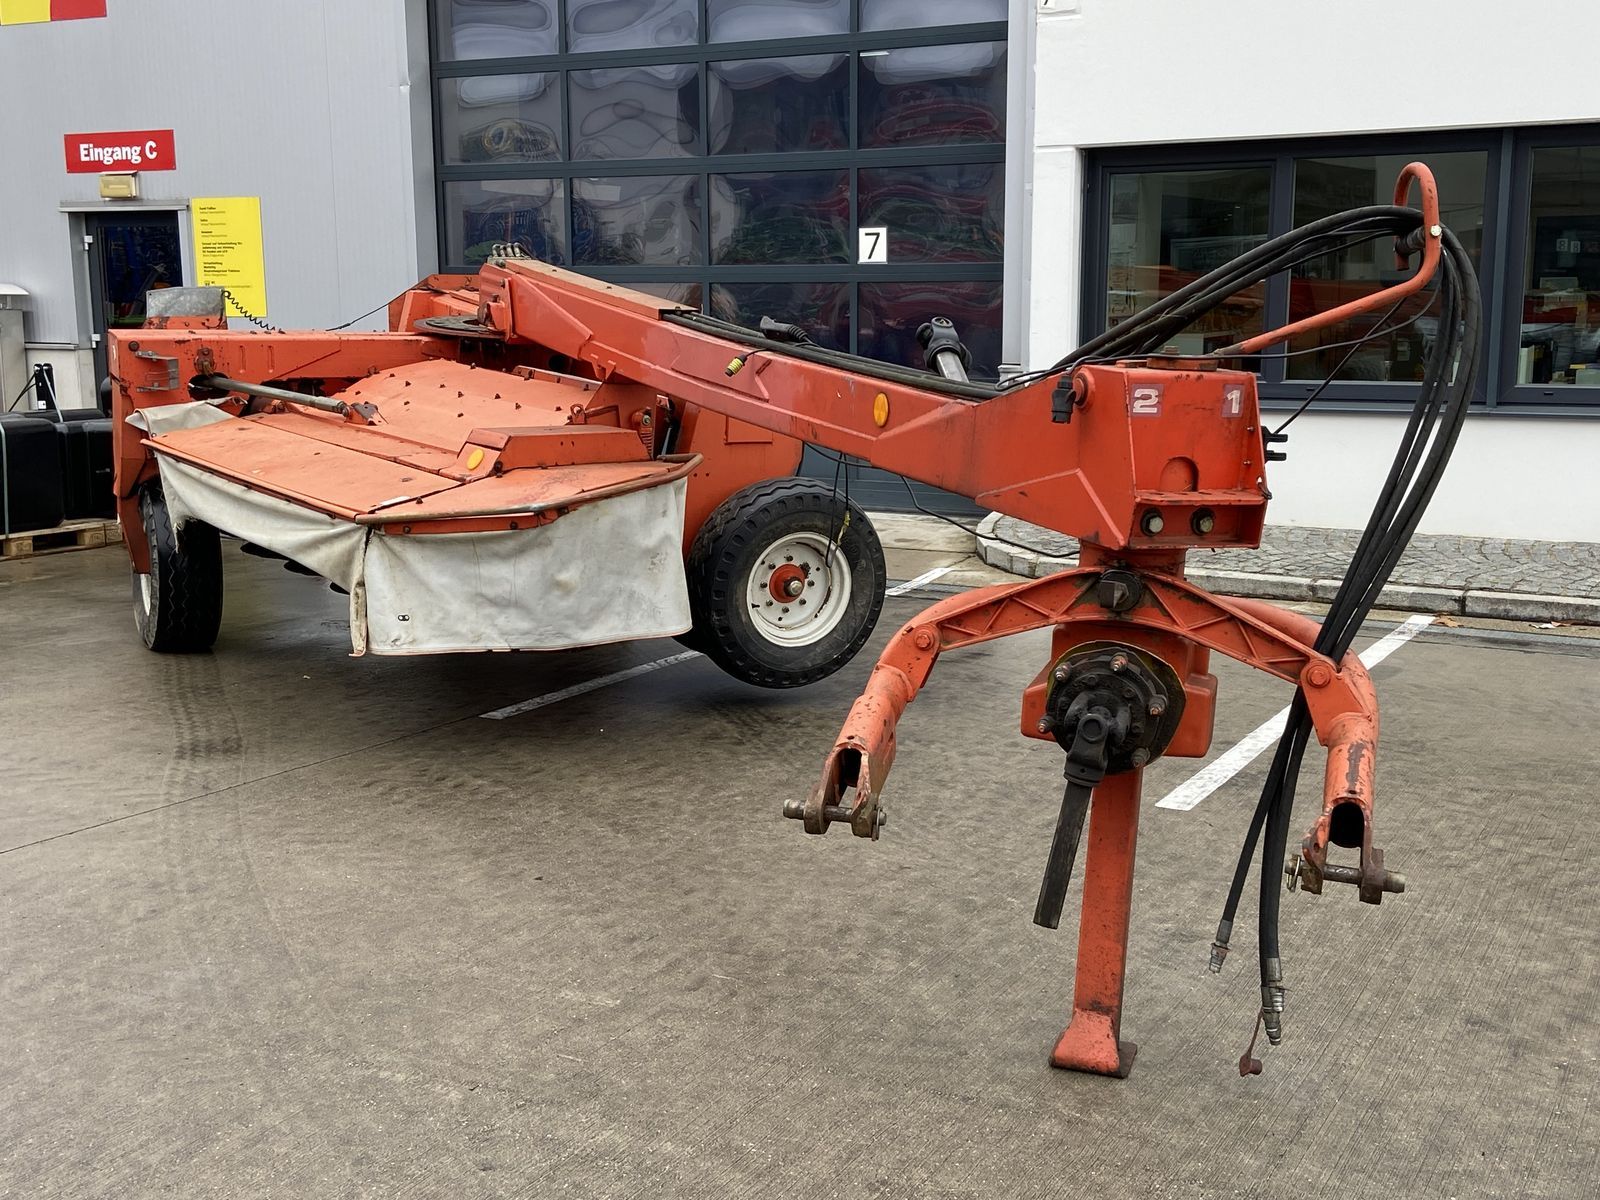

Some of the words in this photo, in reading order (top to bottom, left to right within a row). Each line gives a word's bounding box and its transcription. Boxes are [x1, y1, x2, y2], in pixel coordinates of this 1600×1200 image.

[79, 143, 142, 165] Eingang
[145, 140, 158, 160] C
[864, 232, 881, 260] 7
[1132, 388, 1159, 413] 2
[1226, 389, 1241, 414] 1
